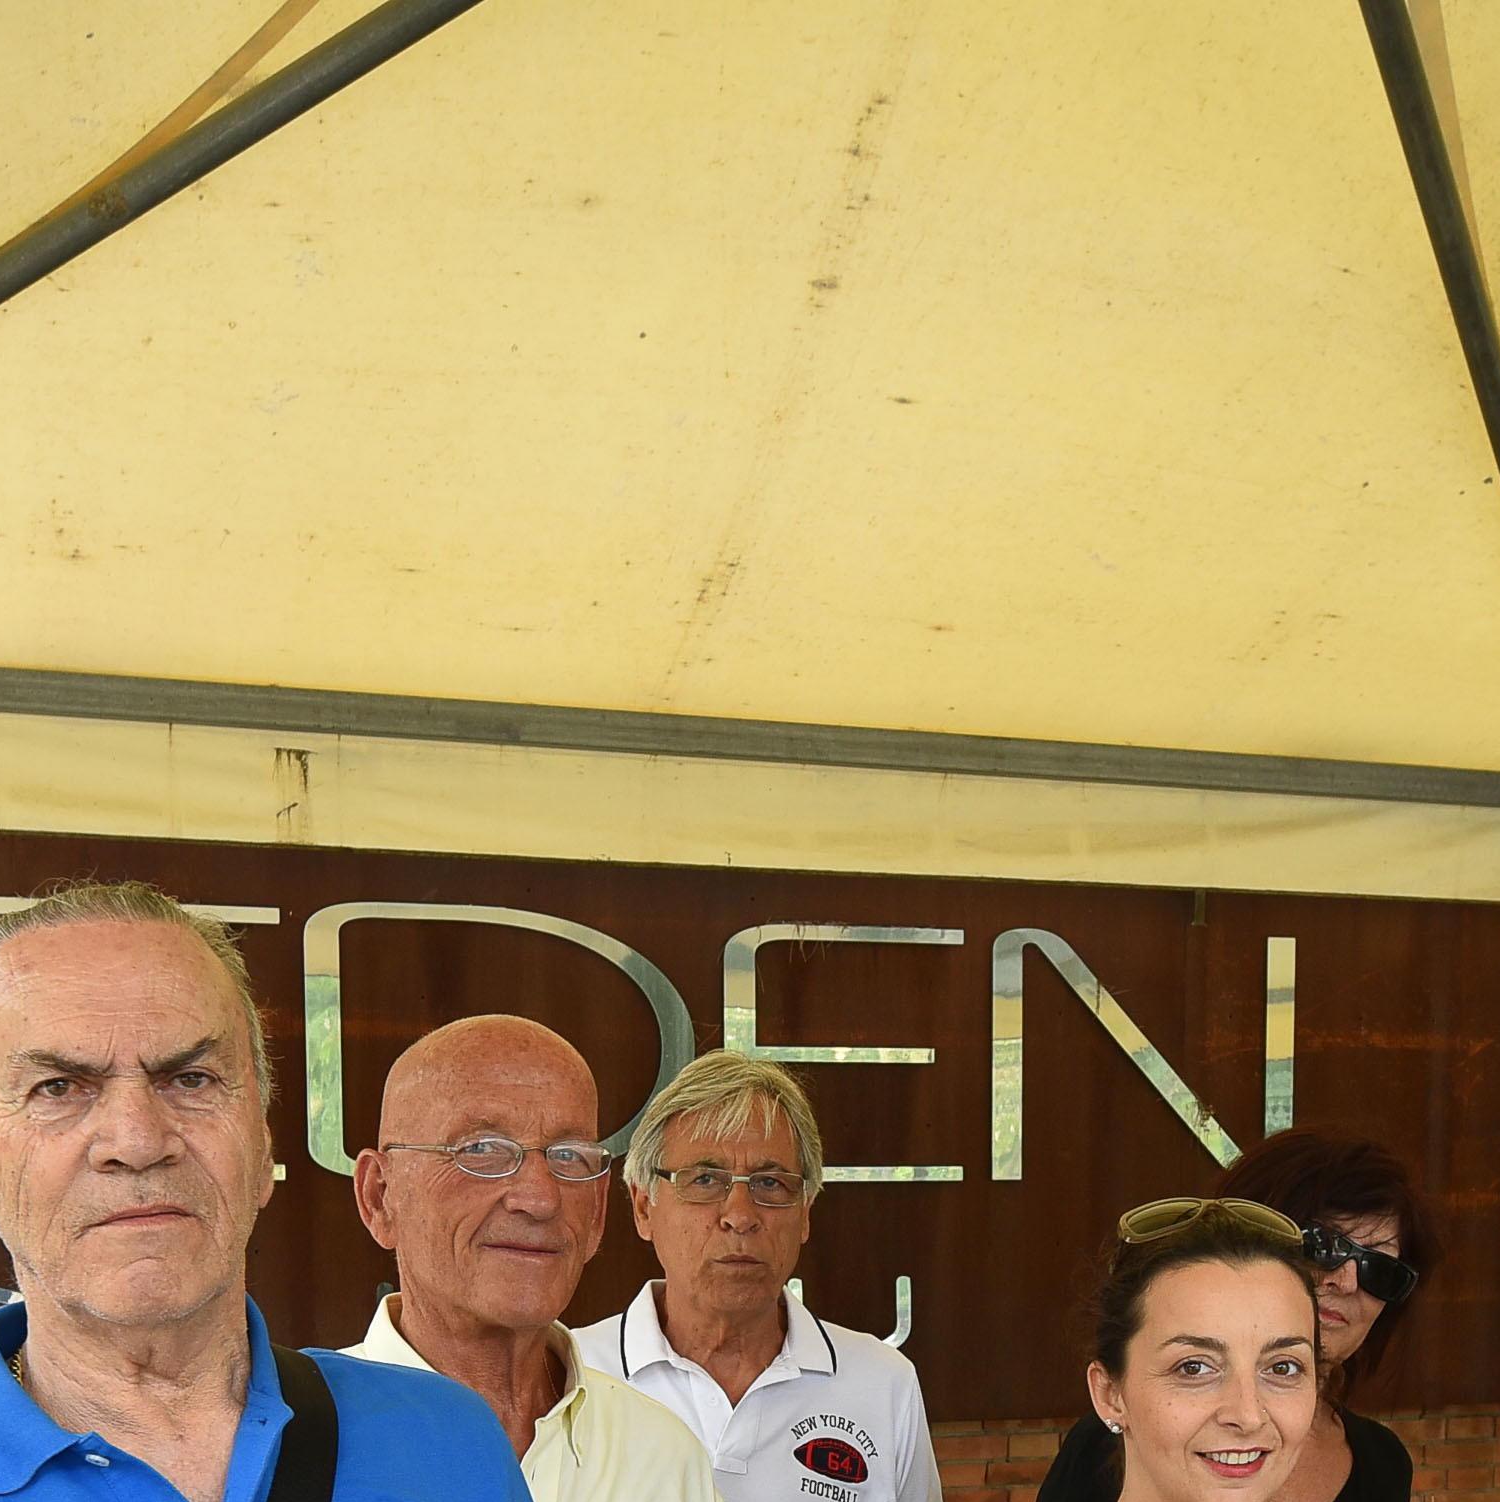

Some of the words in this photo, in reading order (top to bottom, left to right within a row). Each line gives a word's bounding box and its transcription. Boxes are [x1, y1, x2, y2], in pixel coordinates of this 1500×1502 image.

[791, 1417, 817, 1439] NEW
[820, 1415, 855, 1434] YORK
[856, 1430, 878, 1457] CITY
[828, 1452, 852, 1473] 64
